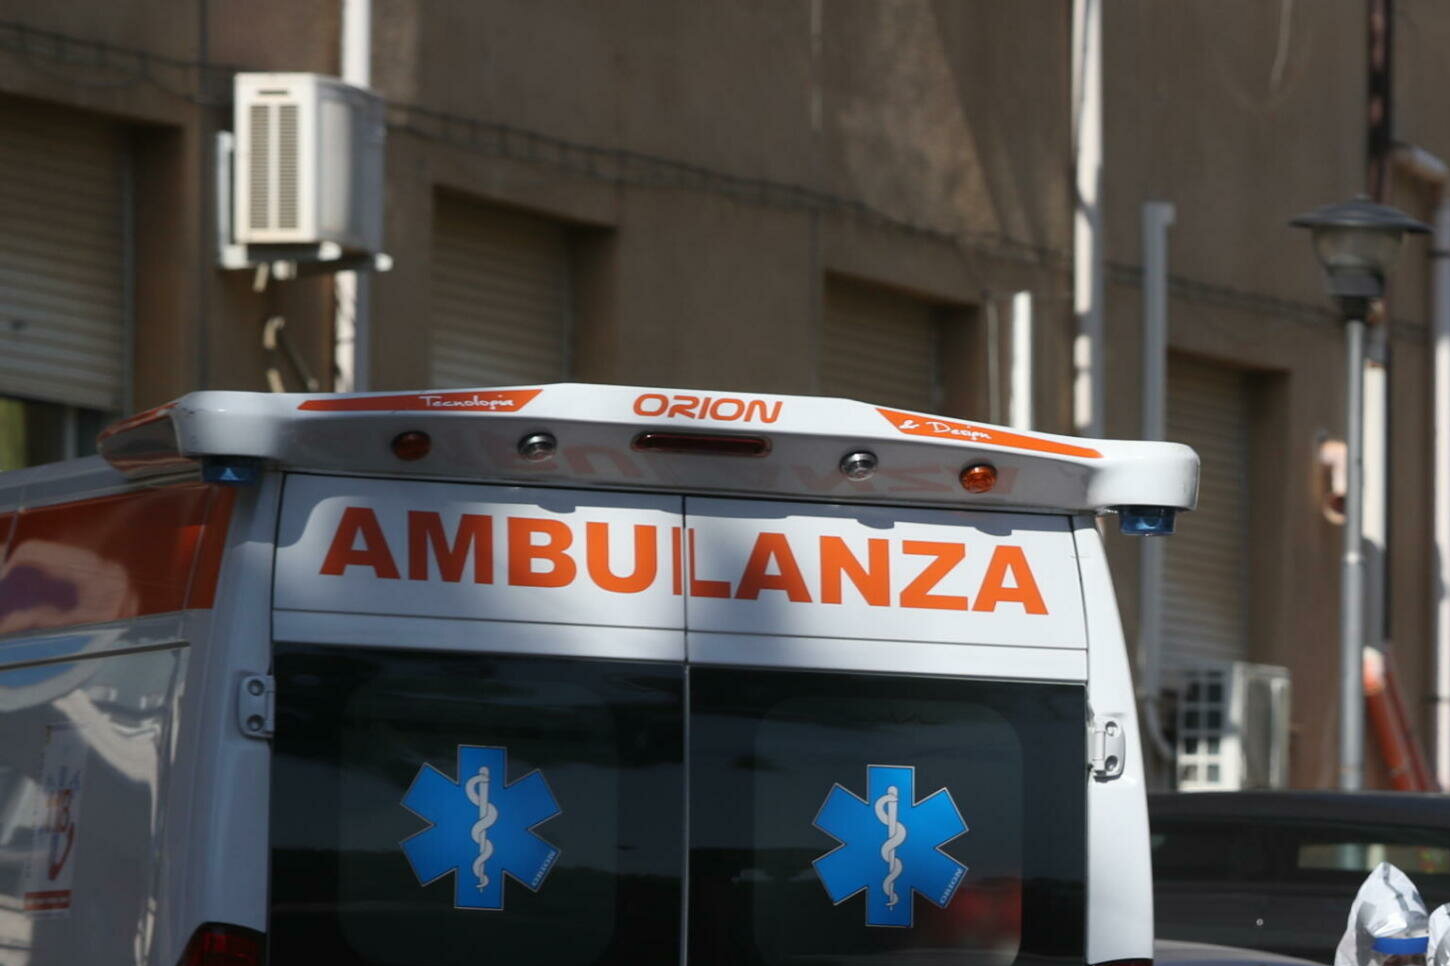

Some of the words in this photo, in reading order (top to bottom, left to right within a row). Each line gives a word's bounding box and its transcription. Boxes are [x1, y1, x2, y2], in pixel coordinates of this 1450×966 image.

[418, 395, 514, 410] Tecnologia
[633, 393, 783, 424] ORION
[899, 419, 920, 430] &
[926, 421, 992, 440] Design
[319, 506, 1049, 615] AMBULANZA
